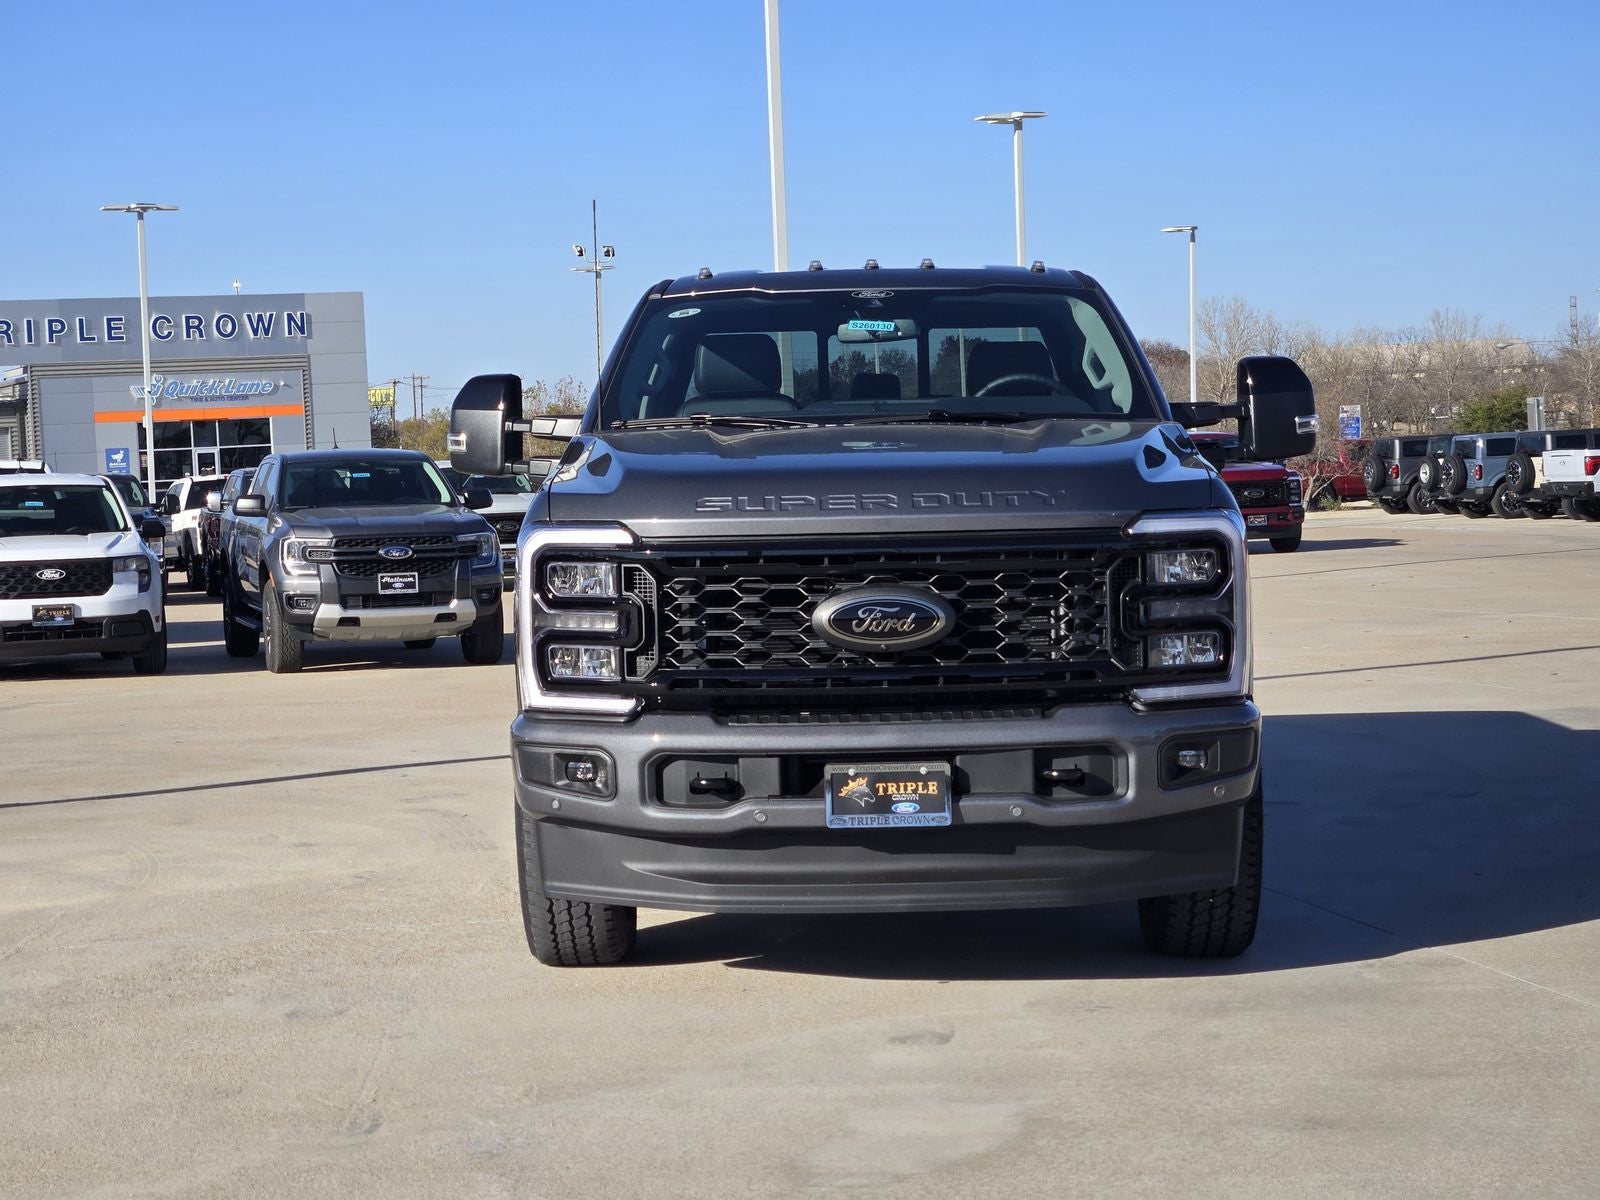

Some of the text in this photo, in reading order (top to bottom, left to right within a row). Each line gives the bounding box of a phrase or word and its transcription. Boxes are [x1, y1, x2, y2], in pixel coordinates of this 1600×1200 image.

[0, 311, 307, 345] RIPLE CROWN
[851, 322, 892, 330] S260130
[164, 378, 275, 399] Quick Lane
[696, 490, 1067, 512] SUPER DUTY
[851, 606, 917, 633] Ford
[831, 763, 946, 772] wwwTripleCrownForcom
[875, 781, 938, 796] TRIPLE
[891, 793, 919, 801] CROWN
[848, 816, 891, 826] TRIPLE
[893, 815, 931, 825] CROWN
